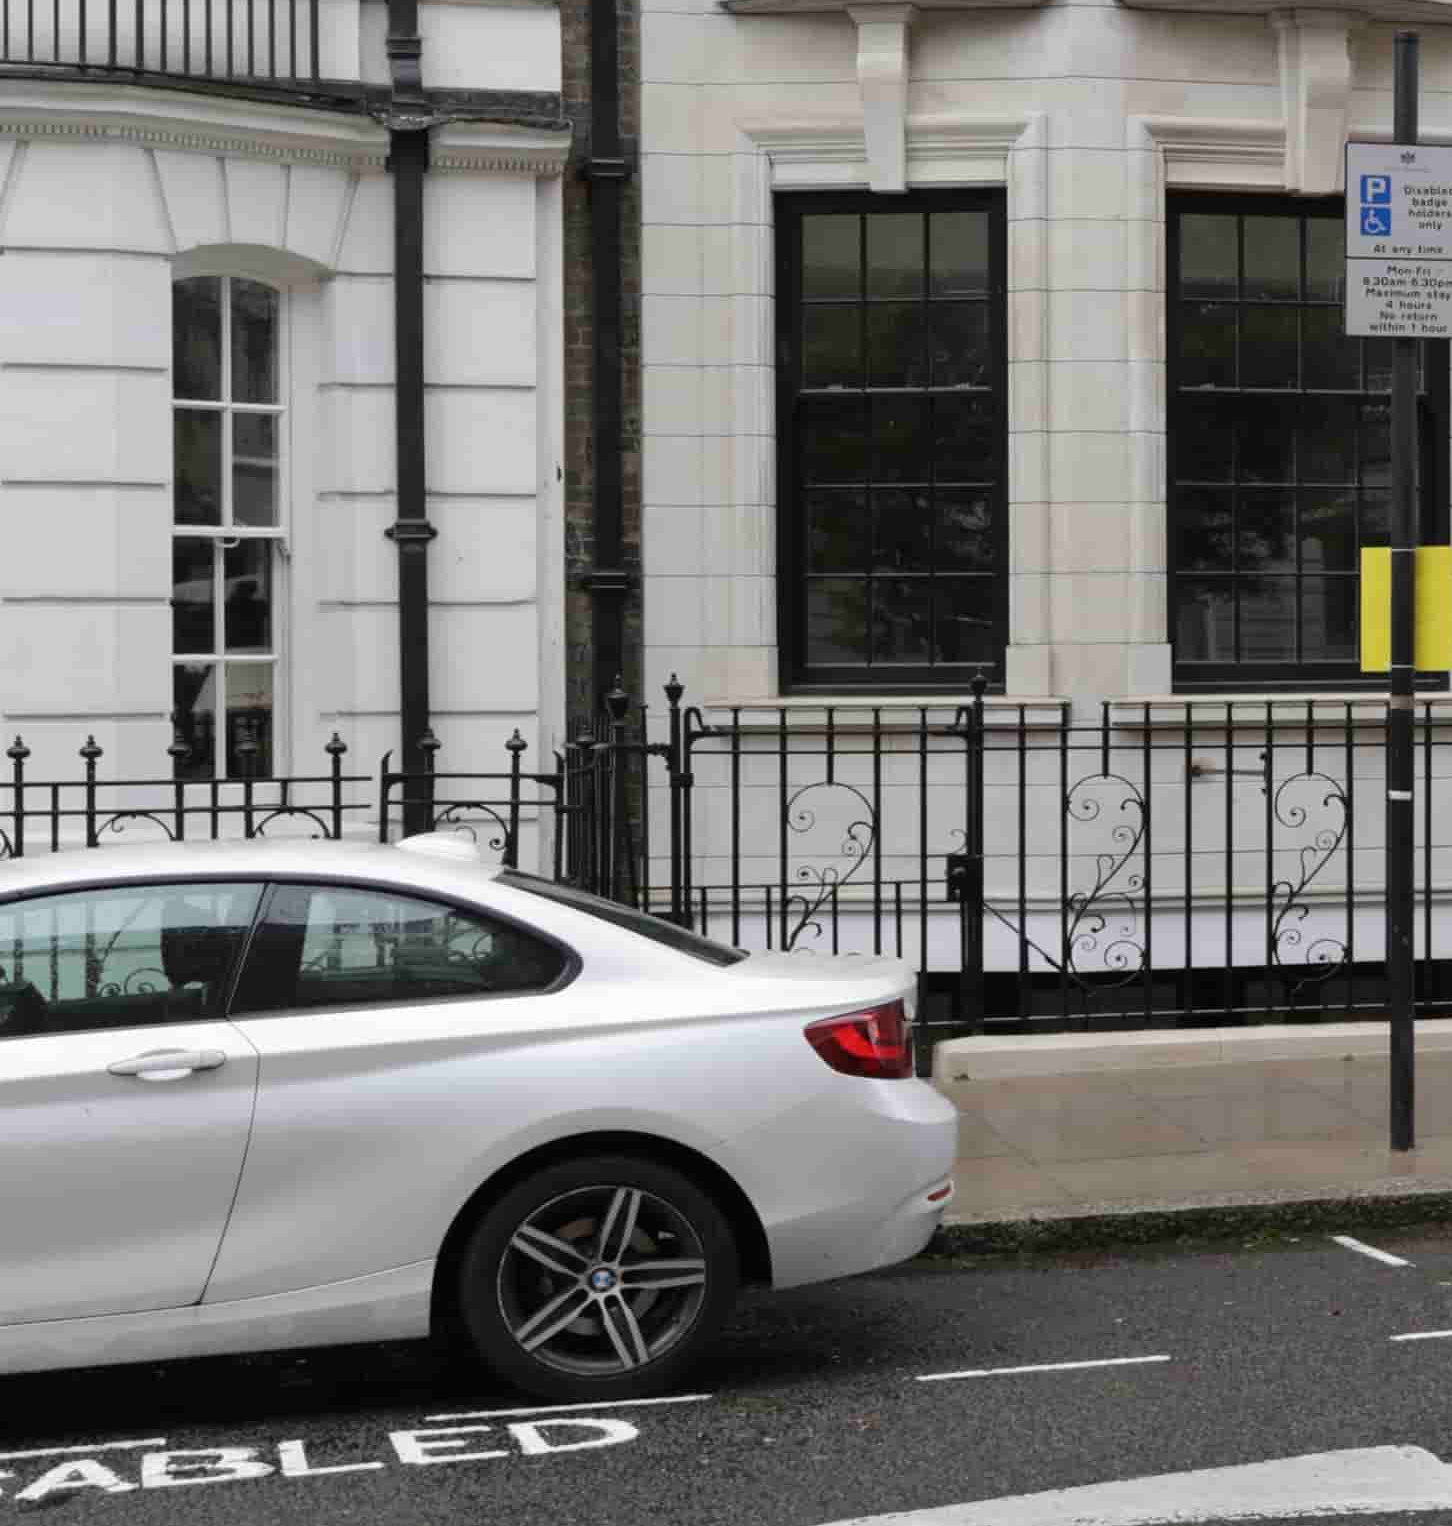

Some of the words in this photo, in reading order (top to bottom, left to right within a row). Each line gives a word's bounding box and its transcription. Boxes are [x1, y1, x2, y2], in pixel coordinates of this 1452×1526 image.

[1367, 177, 1386, 202] P
[1412, 197, 1448, 207] badge
[1408, 209, 1452, 218] holders
[1418, 220, 1443, 230] only
[1373, 244, 1386, 254] At
[1392, 246, 1412, 256] any
[1418, 245, 1444, 254] time
[1365, 288, 1420, 298] Maximum
[1427, 290, 1451, 301] stay
[1385, 301, 1393, 309] 4
[1400, 301, 1432, 310] hours
[1379, 310, 1396, 320] No
[1401, 312, 1438, 321] return
[1369, 323, 1405, 332] within
[1422, 324, 1448, 333] hour
[0, 1418, 640, 1500] ABLED
